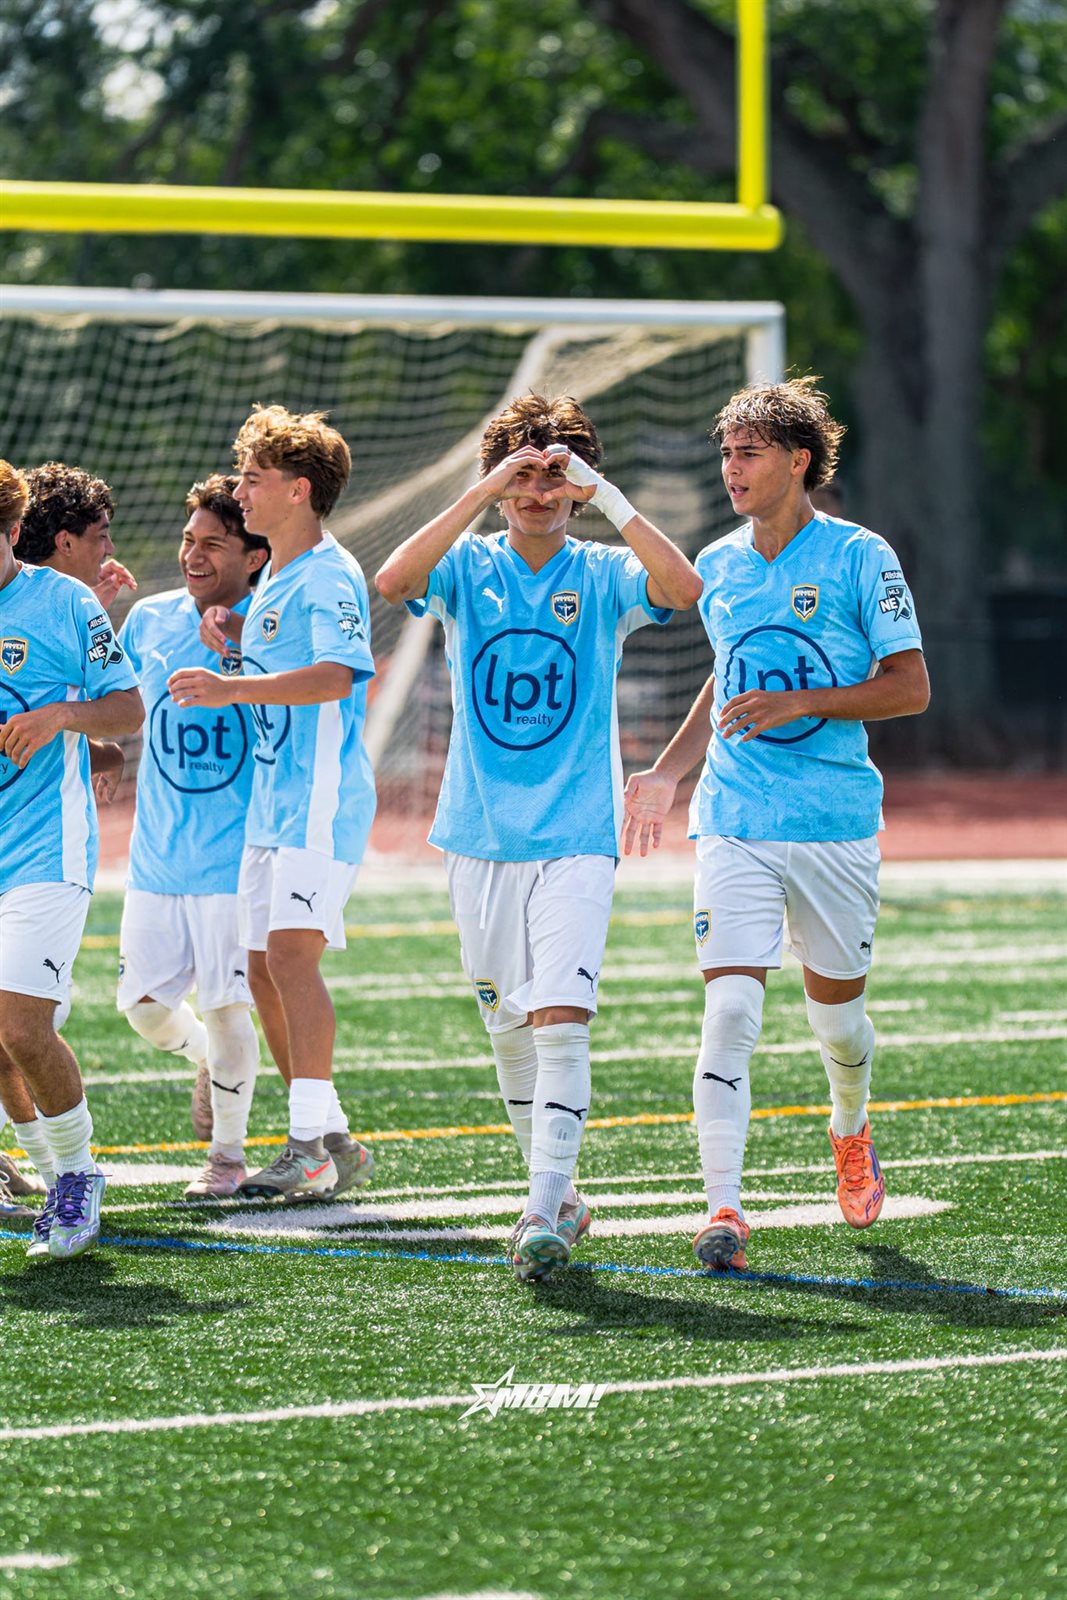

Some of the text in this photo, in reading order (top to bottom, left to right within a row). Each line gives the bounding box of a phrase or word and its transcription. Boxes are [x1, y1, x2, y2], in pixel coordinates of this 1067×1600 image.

[94, 634, 108, 643] MLS
[485, 653, 564, 723] lpt
[516, 713, 554, 728] realty
[161, 709, 232, 769] lpt
[189, 760, 225, 775] realty
